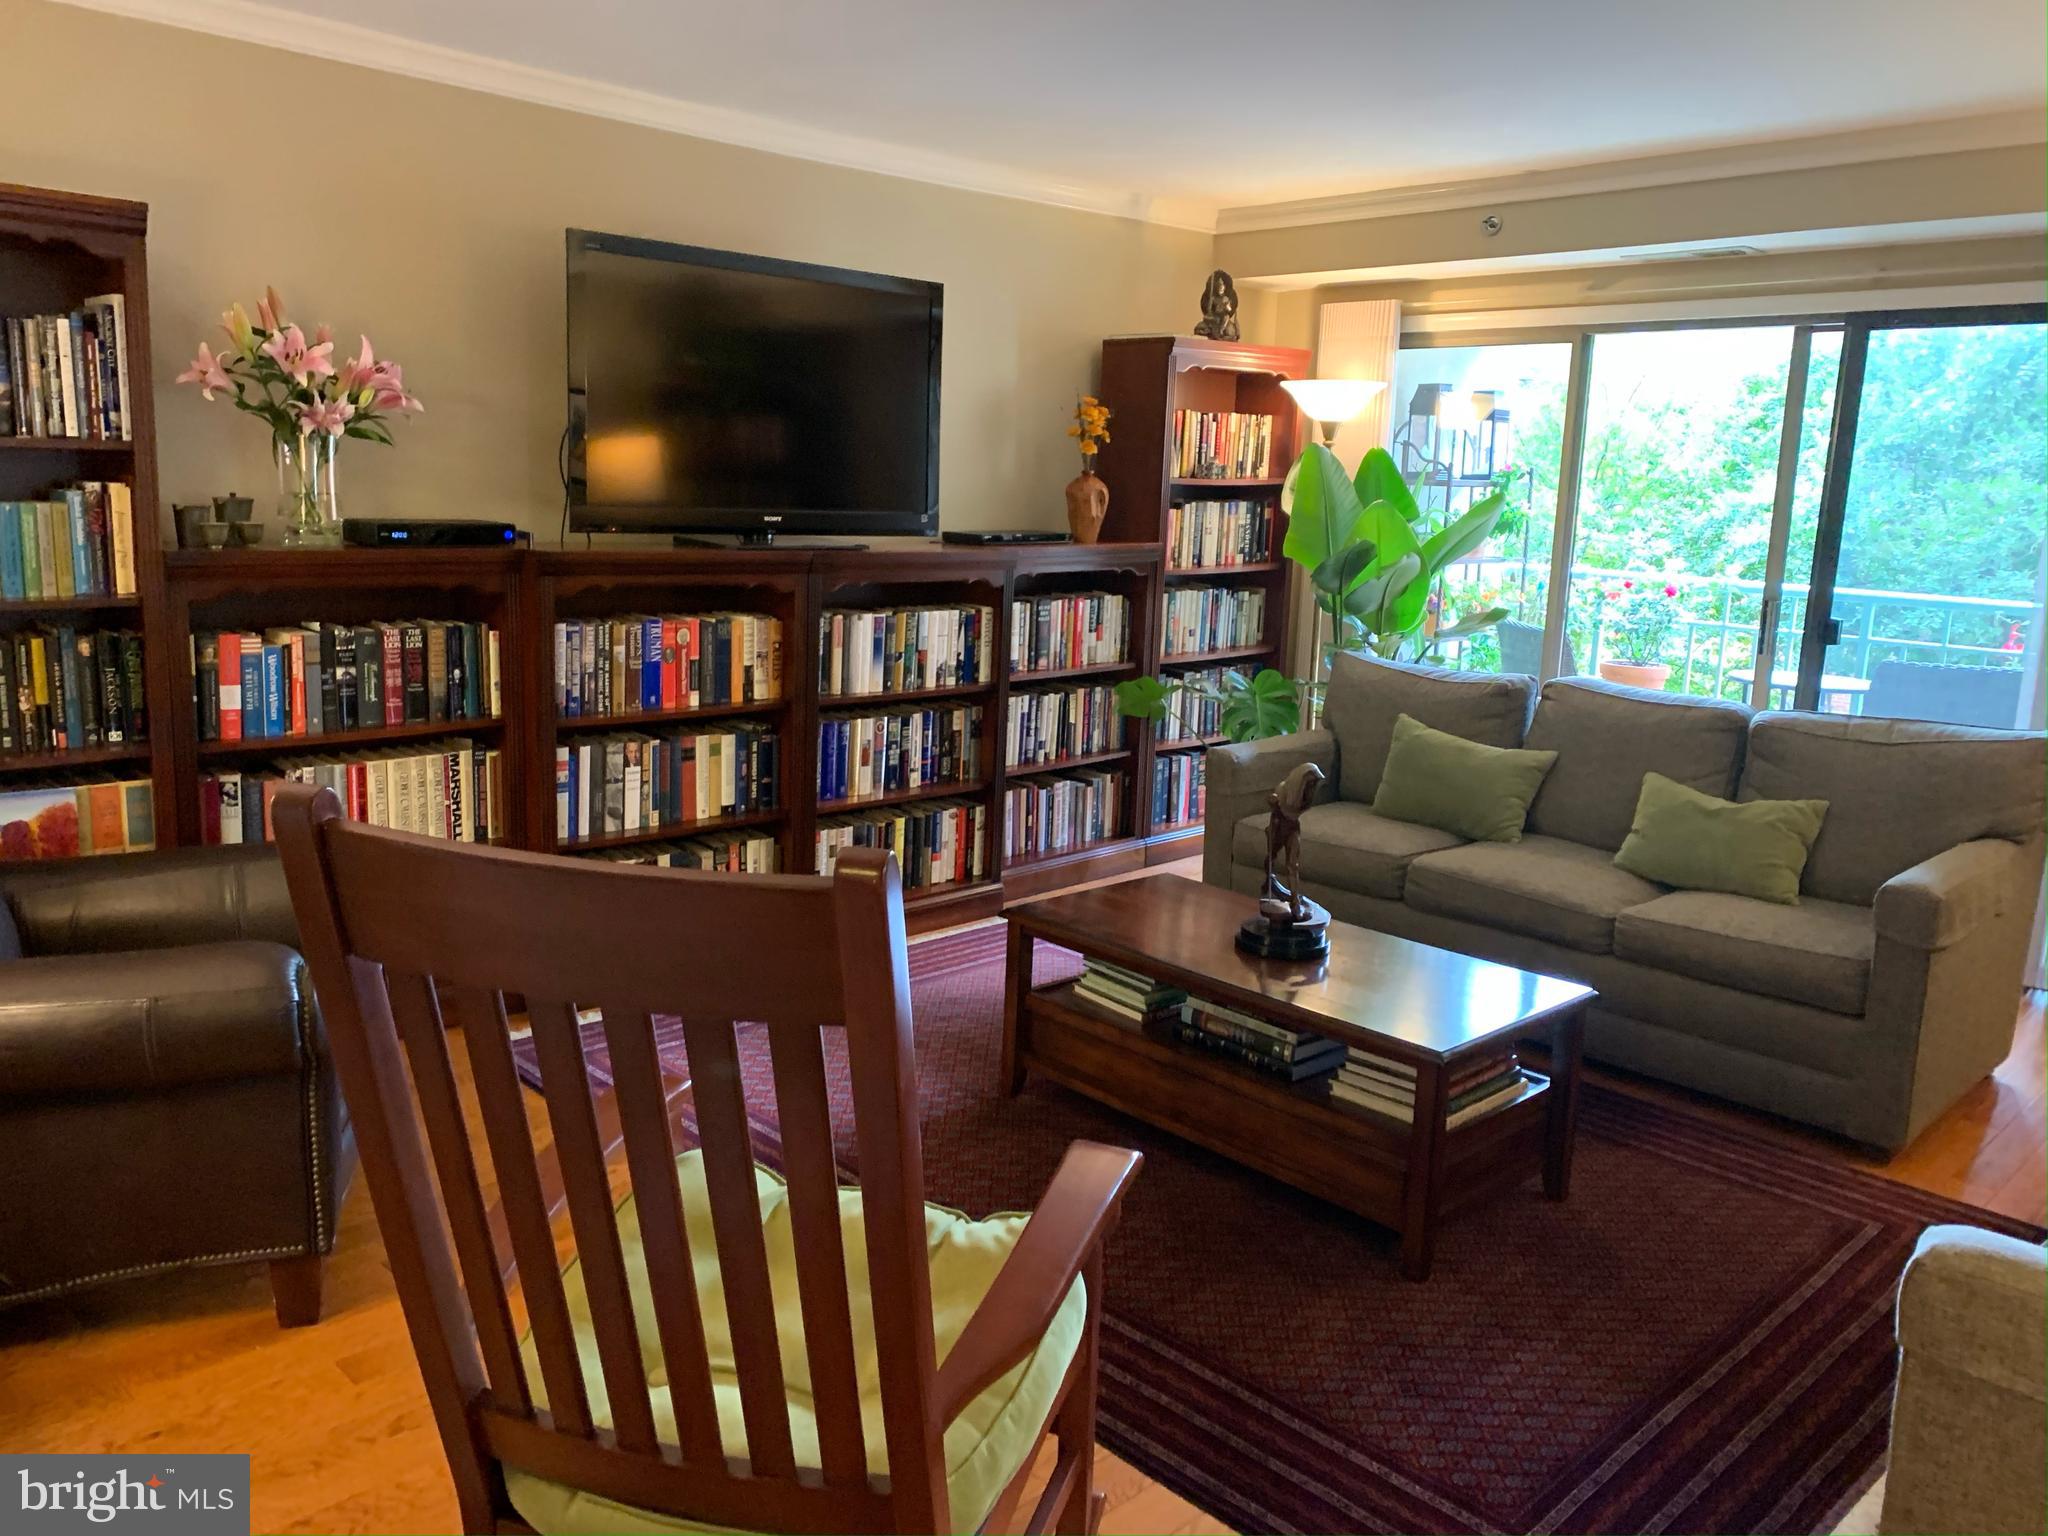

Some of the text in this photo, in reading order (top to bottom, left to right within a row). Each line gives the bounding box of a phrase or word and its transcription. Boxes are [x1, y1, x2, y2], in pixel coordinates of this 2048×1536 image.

[650, 622, 662, 662] TRUMAN
[104, 667, 117, 715] JACKSON
[245, 667, 254, 710] TRIUMPH
[449, 752, 462, 840] MARSHALL
